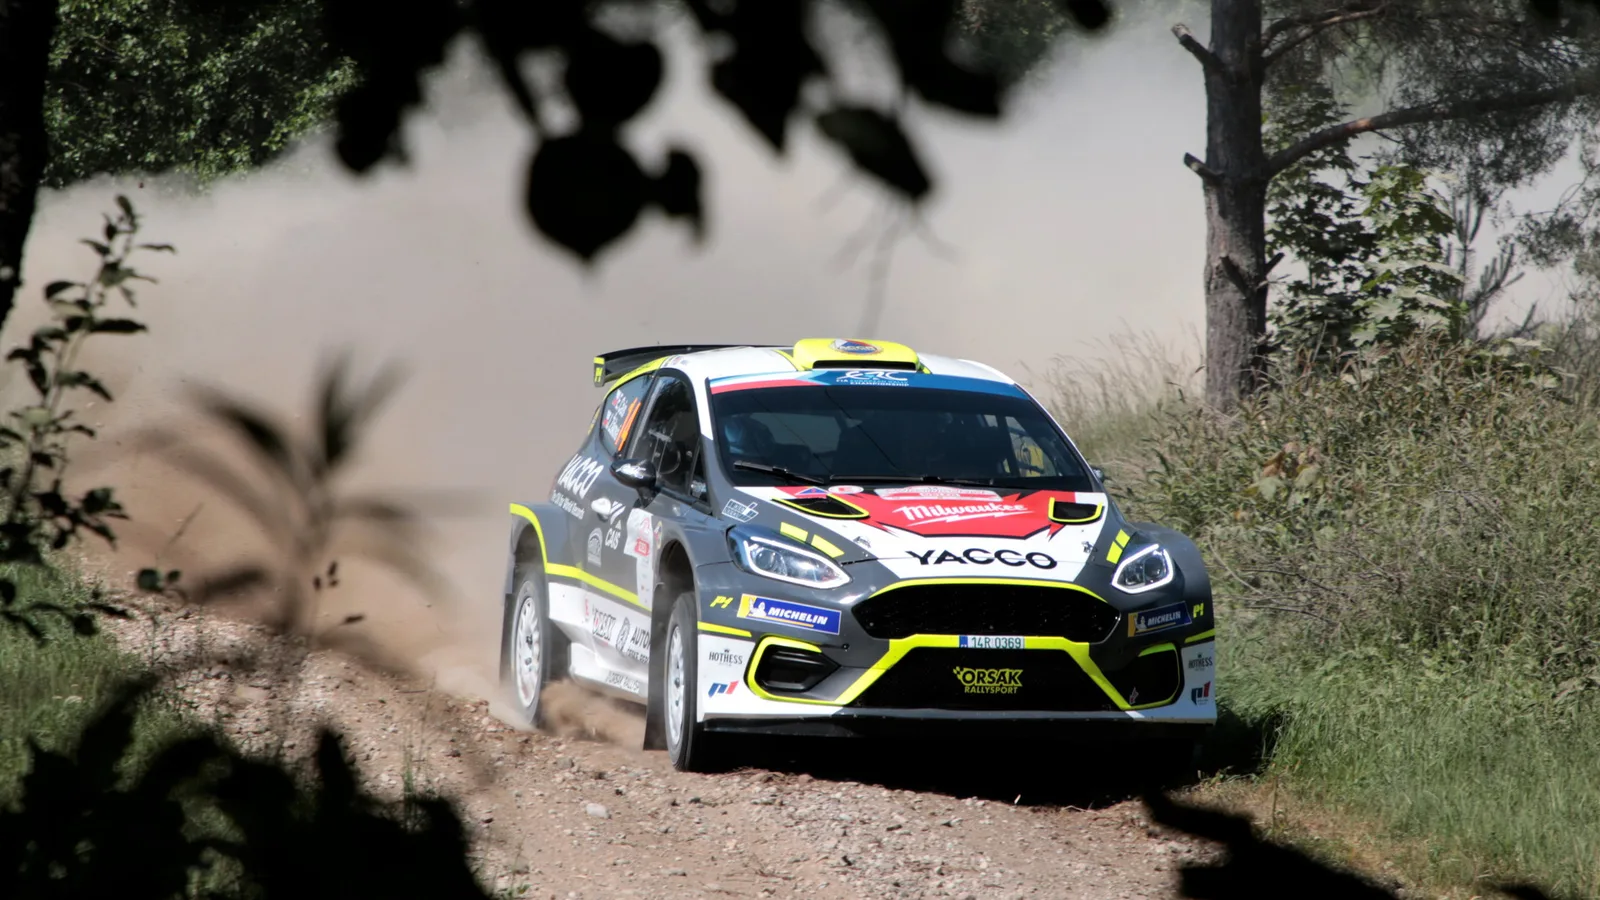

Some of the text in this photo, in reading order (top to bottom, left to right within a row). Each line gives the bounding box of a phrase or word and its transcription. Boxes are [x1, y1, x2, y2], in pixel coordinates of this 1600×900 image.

[557, 453, 604, 499] YACCO
[892, 502, 1029, 521] Milwaukee
[905, 548, 1058, 569] YACCO
[768, 606, 828, 625] MICHELIN
[1147, 611, 1181, 626] MICHELIN
[971, 637, 1021, 649] 14R 0369
[709, 651, 743, 665] HOTHESS
[960, 667, 1023, 687] ORSAK
[964, 686, 1018, 694] RALLYSPORT
